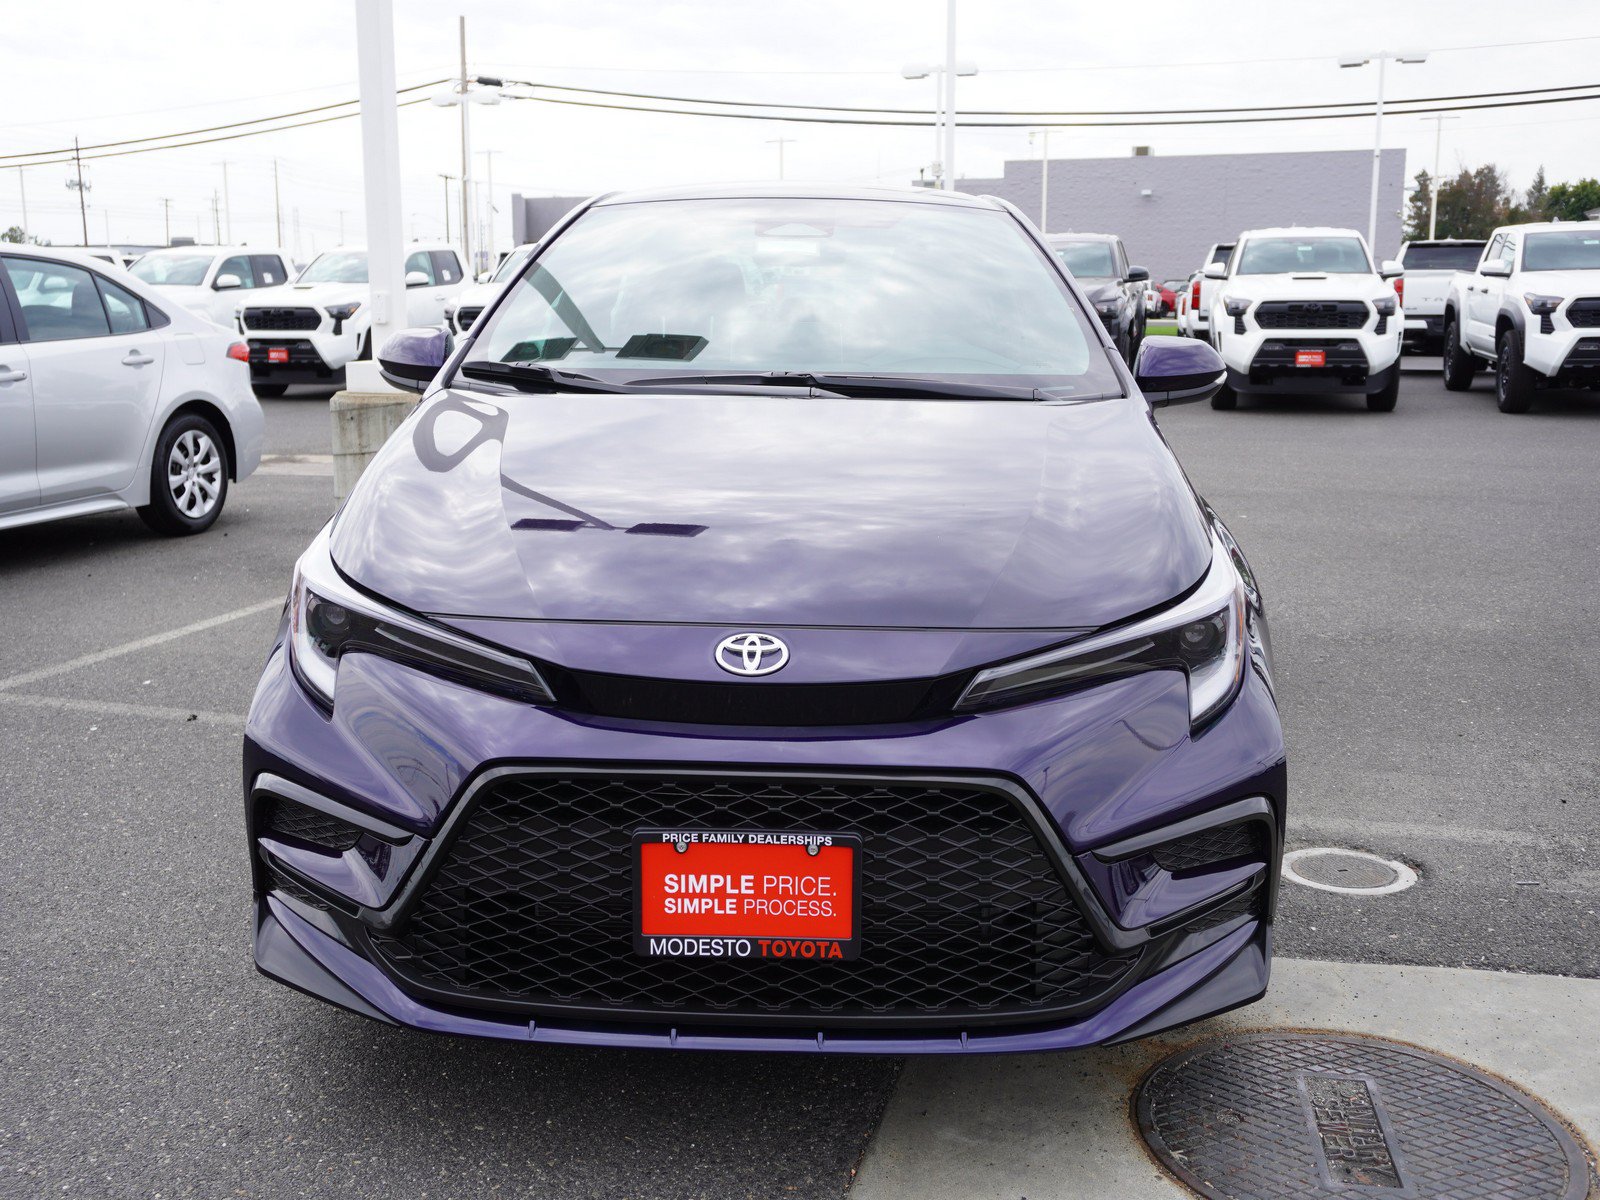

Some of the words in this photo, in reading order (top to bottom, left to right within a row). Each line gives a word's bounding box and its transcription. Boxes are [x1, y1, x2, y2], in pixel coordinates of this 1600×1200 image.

[662, 833, 699, 843] PRICE
[702, 834, 744, 844] FAMILY
[748, 834, 833, 846] DEALERSHIPS
[664, 874, 754, 894] SIMPLE
[763, 876, 837, 896] PRICE.
[664, 898, 737, 914] SIMPLE
[744, 899, 837, 917] PROCESS.
[650, 939, 751, 957] MODESTO
[758, 939, 843, 959] TOYOTA
[1311, 1096, 1357, 1159] SEWER
